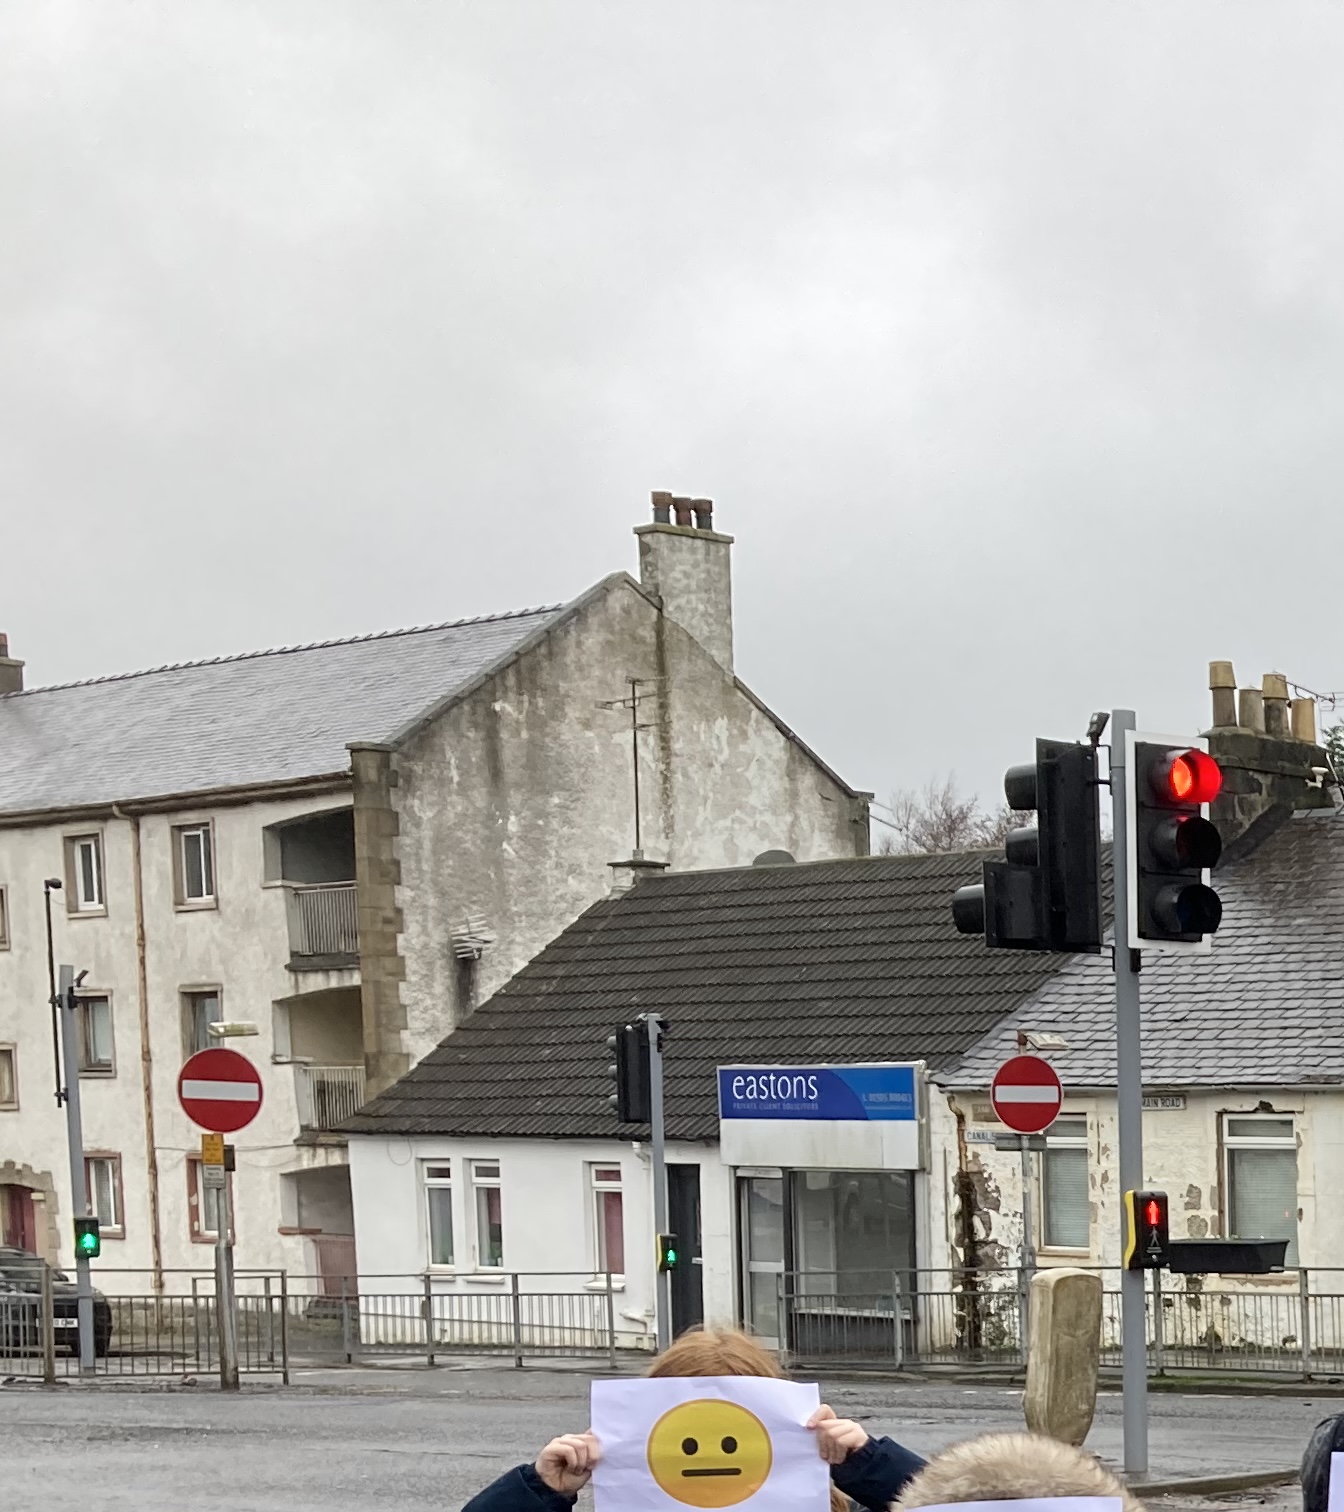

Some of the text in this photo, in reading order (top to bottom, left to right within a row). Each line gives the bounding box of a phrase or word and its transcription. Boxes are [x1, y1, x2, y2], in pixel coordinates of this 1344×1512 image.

[732, 1073, 818, 1100] eastons
[1160, 1097, 1181, 1108] ROAD
[966, 1131, 991, 1141] CANAL
